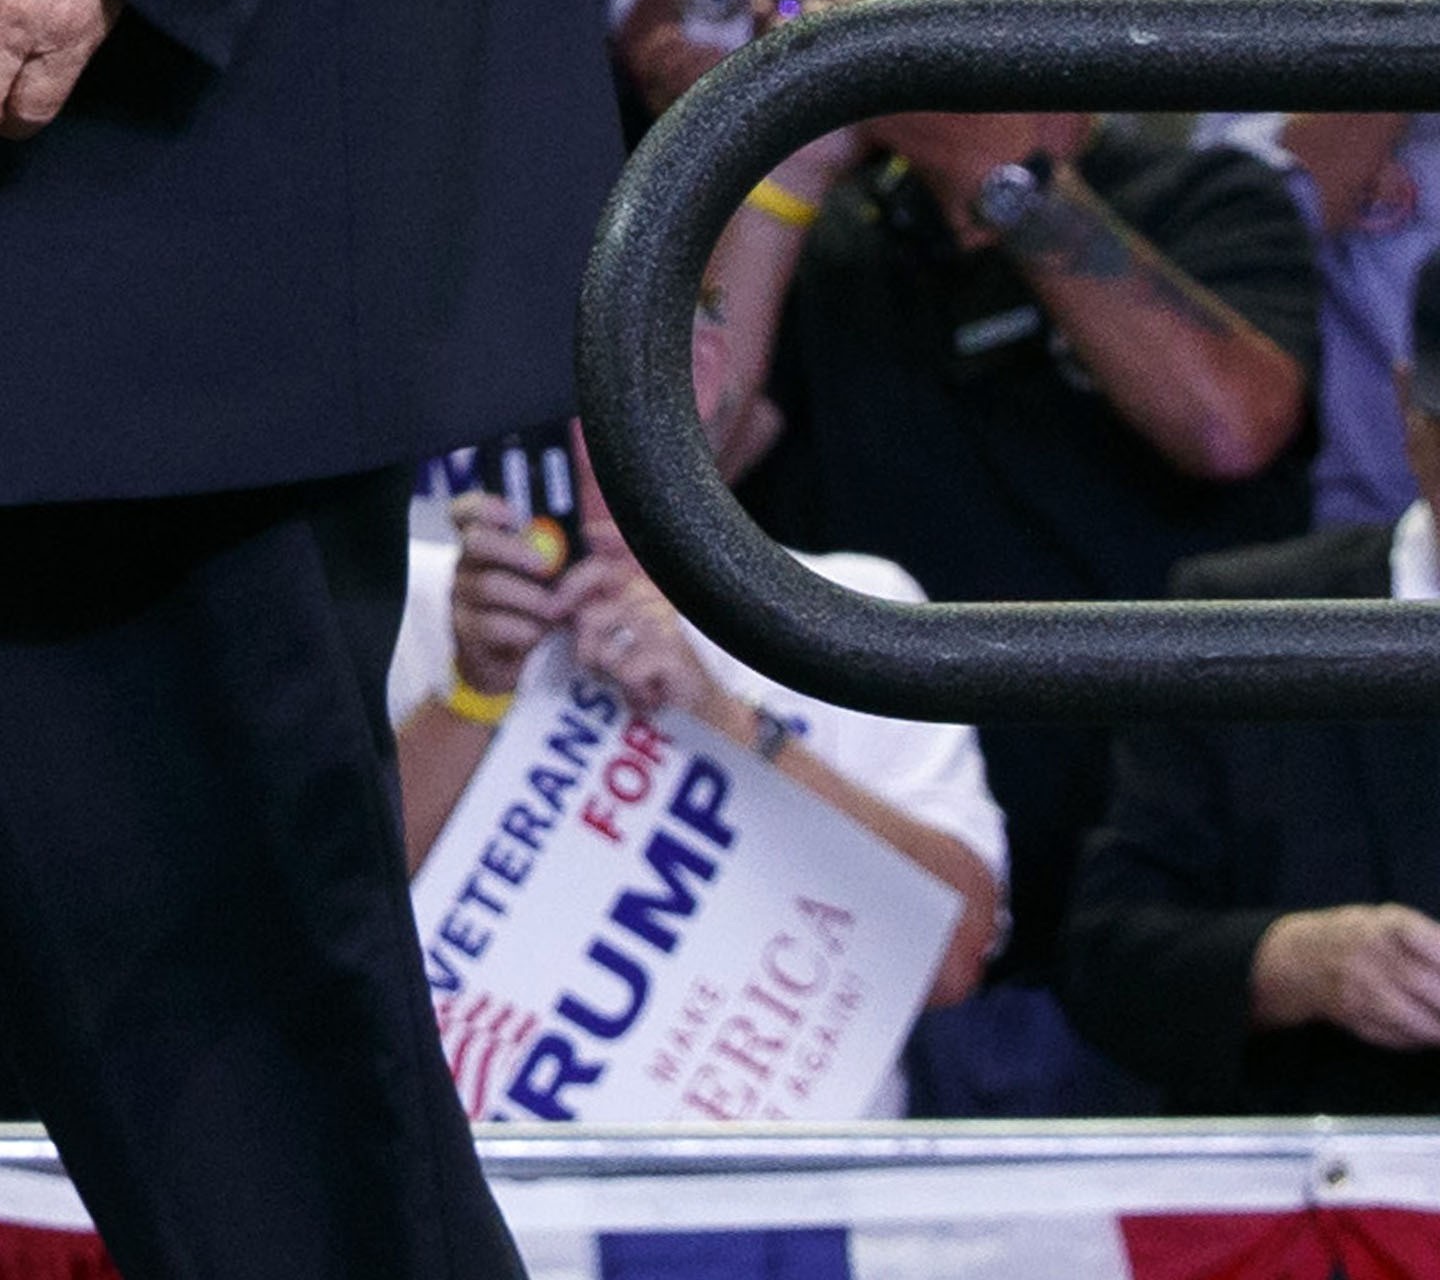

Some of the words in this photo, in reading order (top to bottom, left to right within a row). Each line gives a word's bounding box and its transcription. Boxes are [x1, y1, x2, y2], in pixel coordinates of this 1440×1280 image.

[427, 675, 621, 994] VETERANS
[582, 718, 672, 844] FOR
[492, 753, 737, 1121] RUMP
[684, 894, 858, 1121] ERICA
